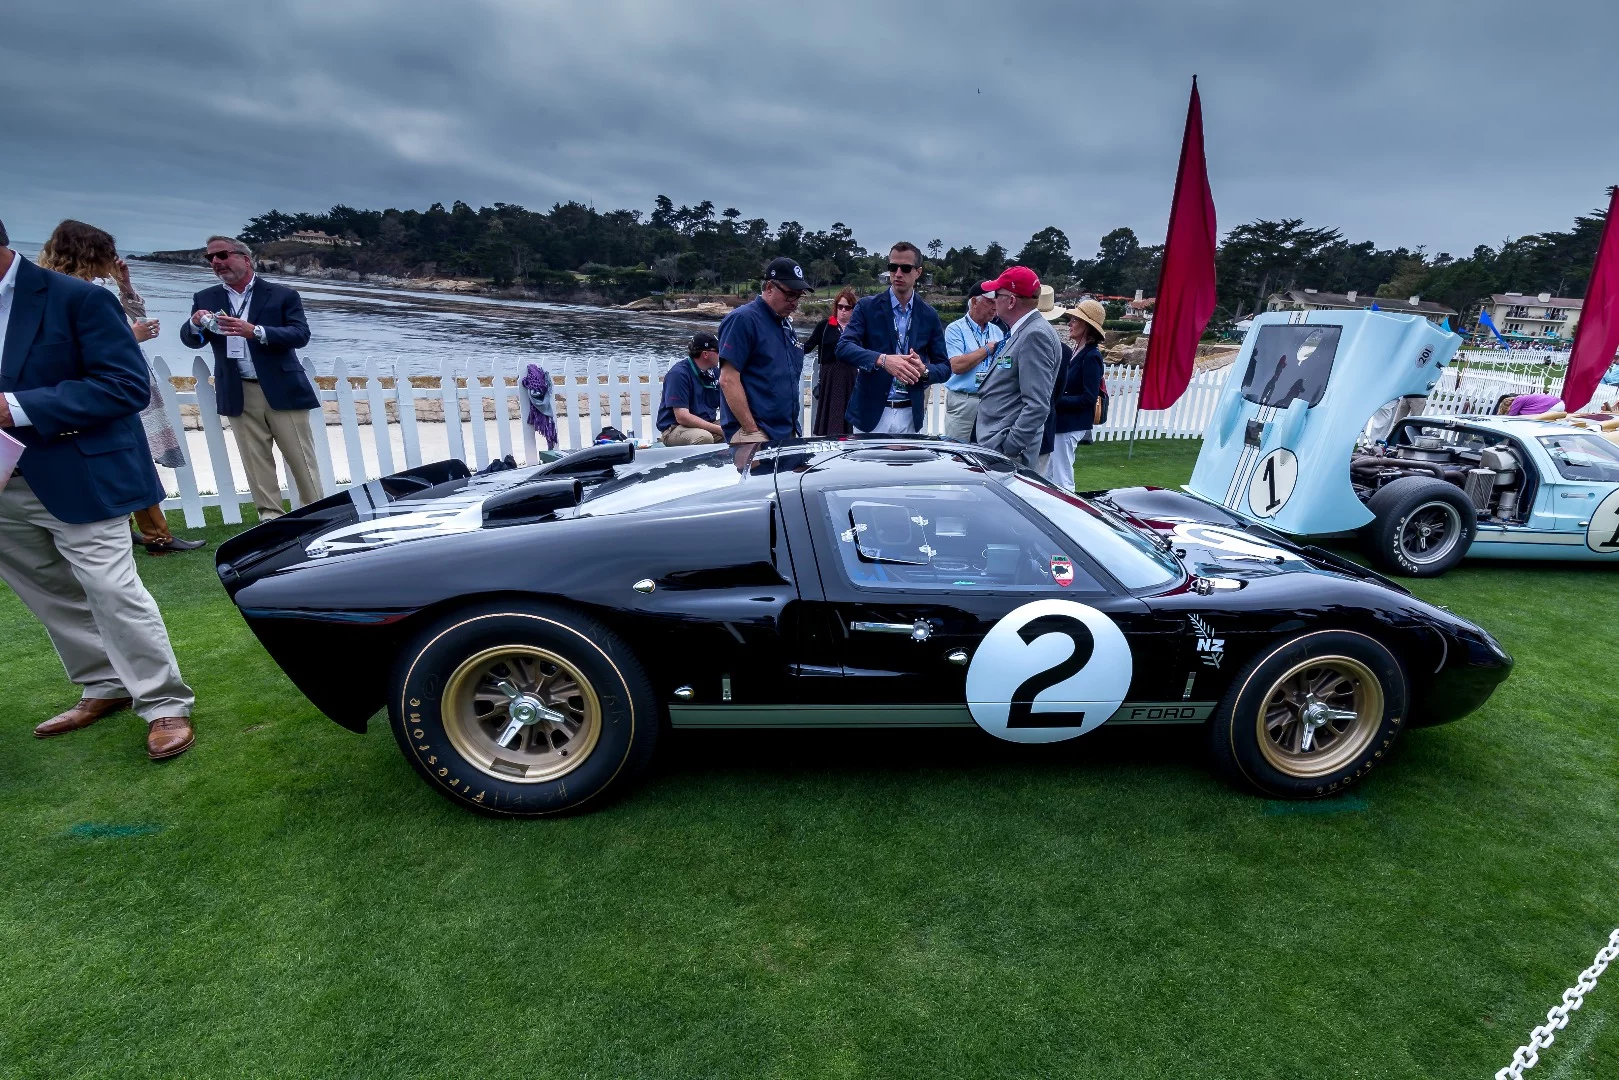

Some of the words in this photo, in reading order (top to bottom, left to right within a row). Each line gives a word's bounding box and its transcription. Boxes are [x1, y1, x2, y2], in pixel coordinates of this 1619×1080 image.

[1418, 348, 1432, 365] 201
[1263, 456, 1281, 513] 1
[1006, 614, 1094, 728] 2
[1130, 707, 1196, 719] FORD
[410, 697, 486, 803] Firestone
